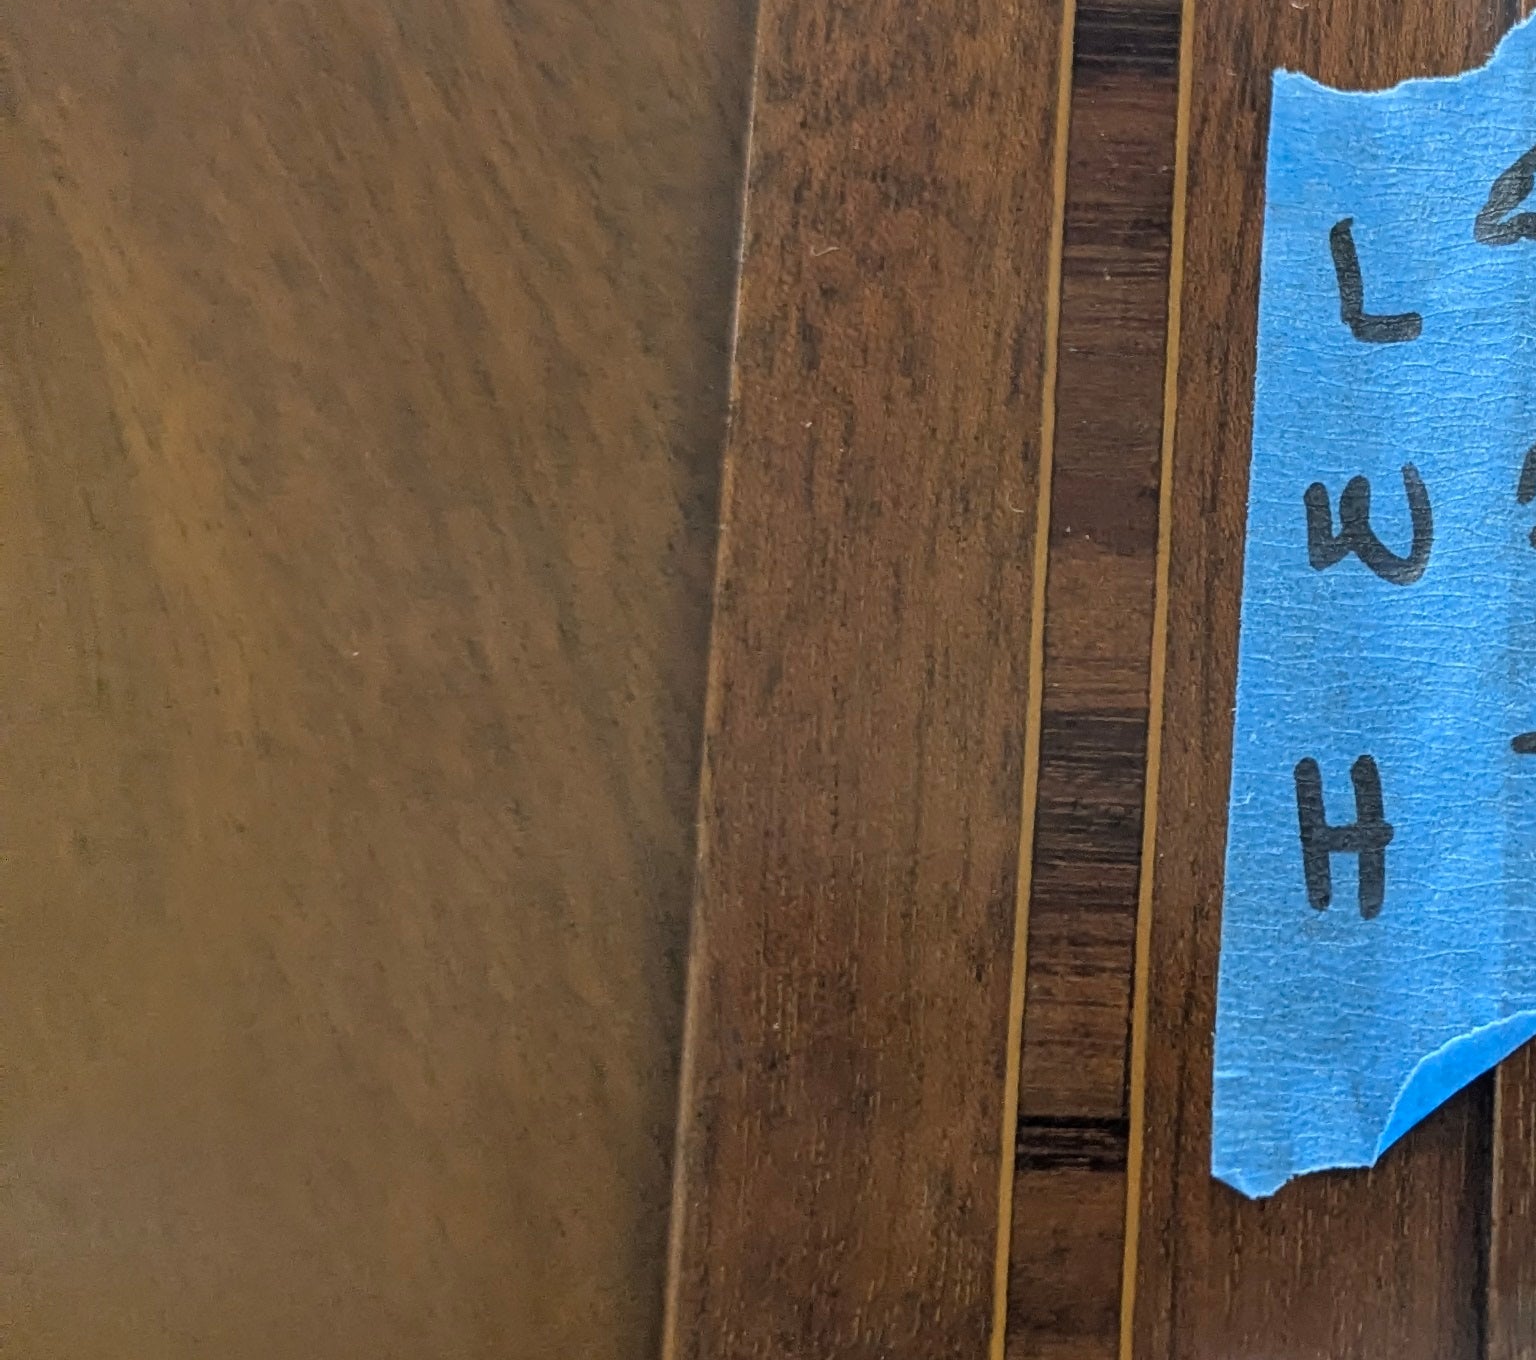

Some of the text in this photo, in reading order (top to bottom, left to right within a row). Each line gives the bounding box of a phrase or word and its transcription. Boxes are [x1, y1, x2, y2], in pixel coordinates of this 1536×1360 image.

[1330, 217, 1422, 344] L
[1303, 462, 1433, 585] W
[1294, 754, 1394, 920] H
